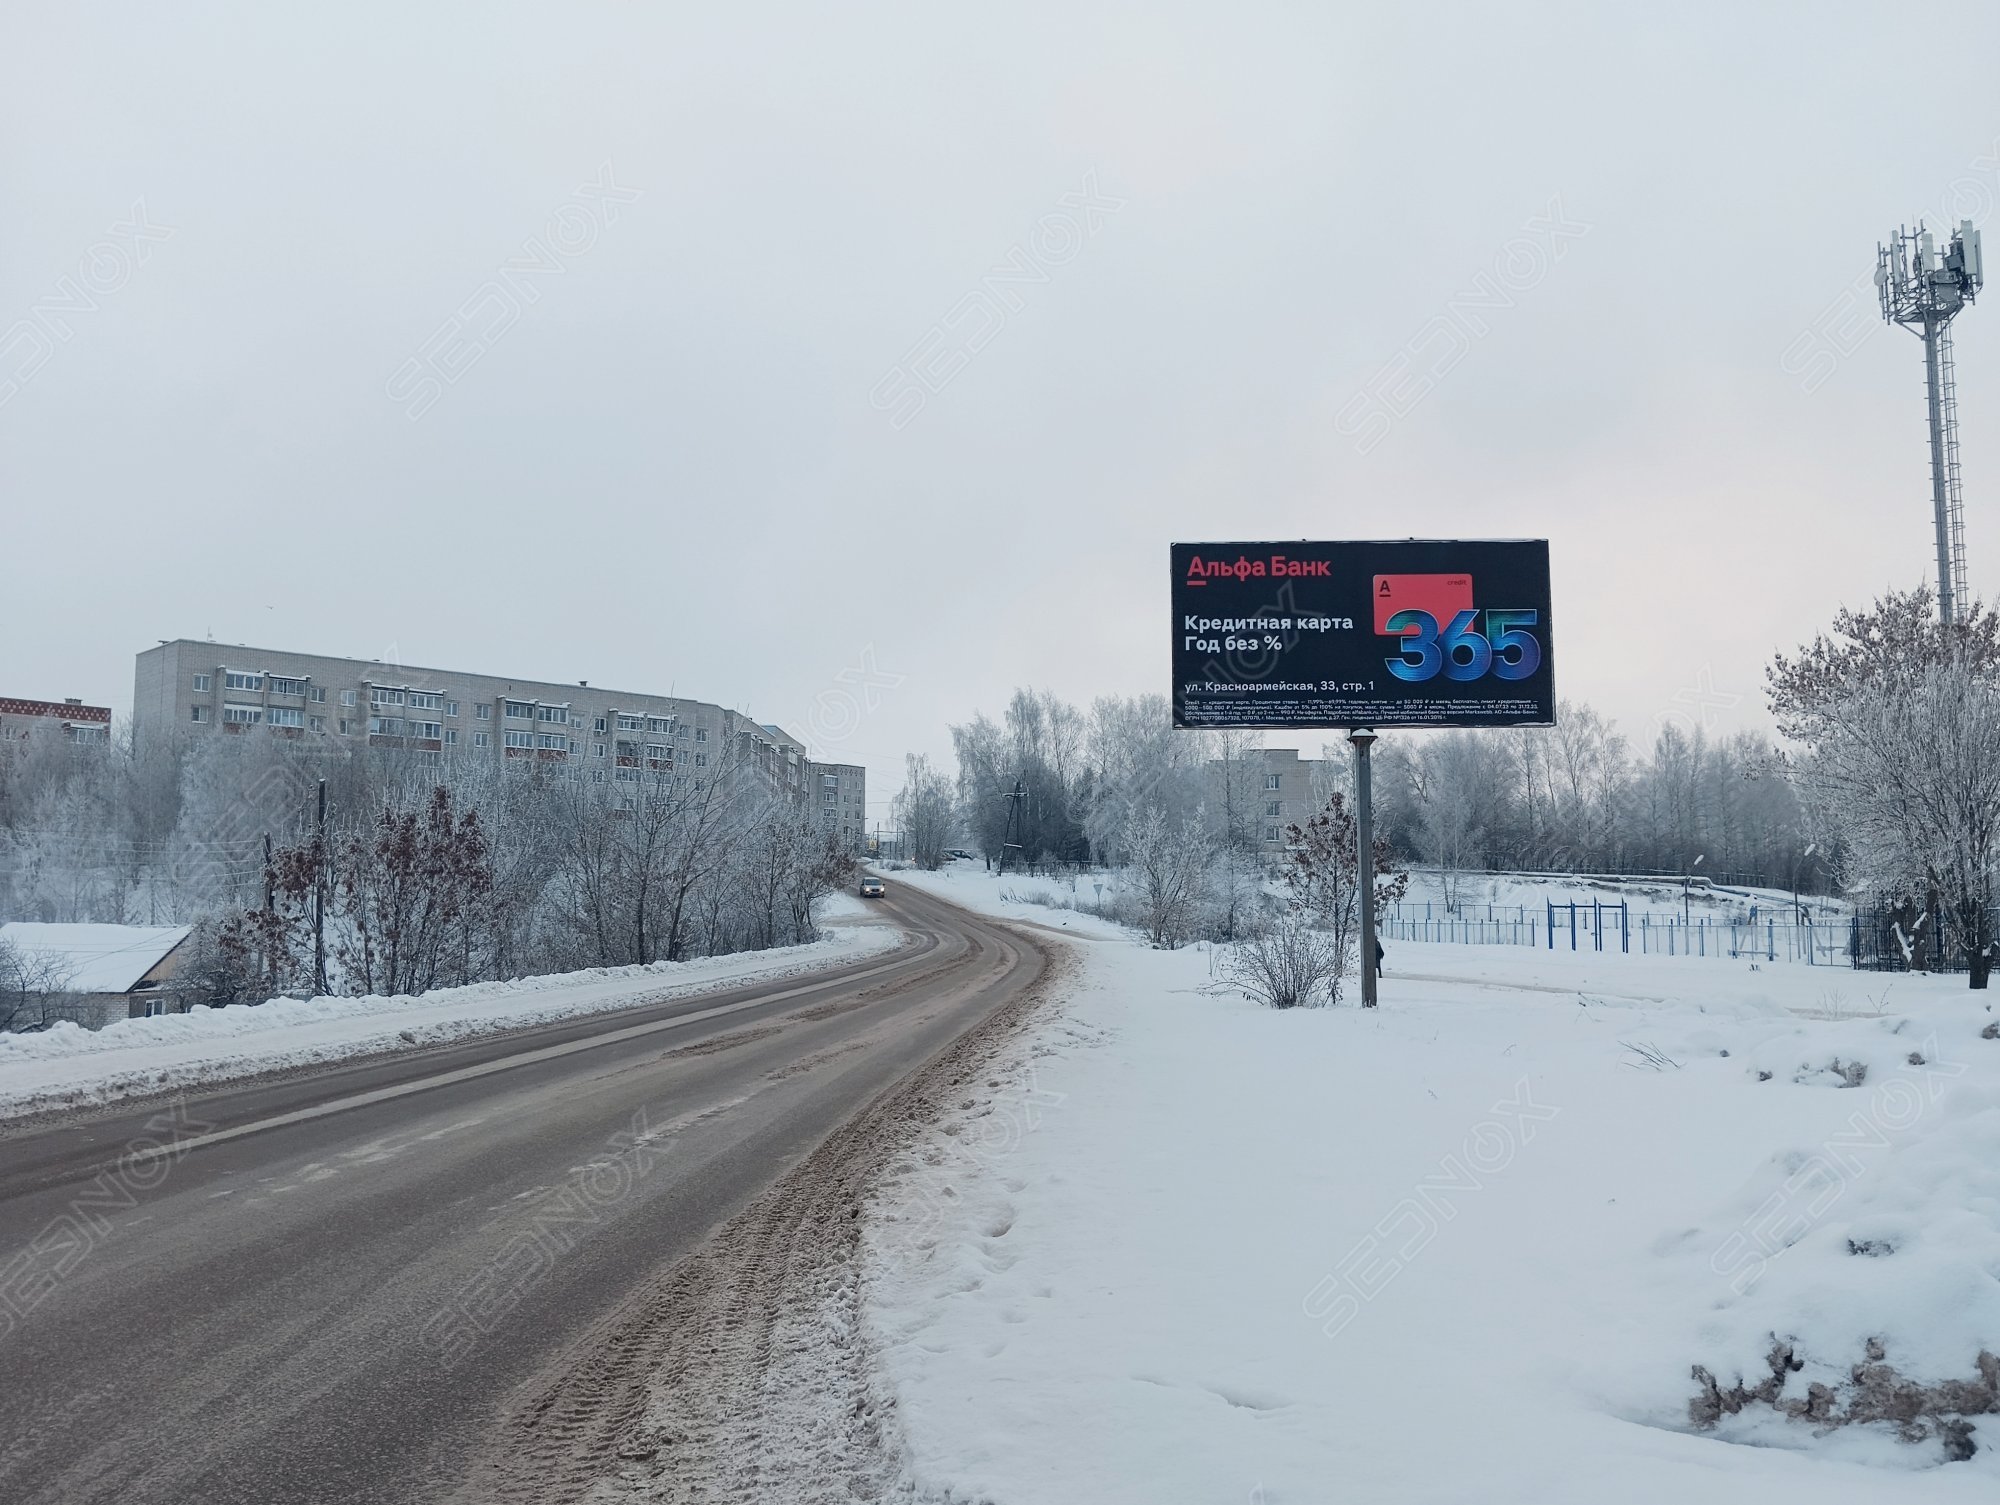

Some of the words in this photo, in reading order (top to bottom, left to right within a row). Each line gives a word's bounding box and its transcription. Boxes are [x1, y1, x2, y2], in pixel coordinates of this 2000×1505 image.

[1187, 556, 1266, 582] Альфа
[1271, 556, 1331, 577] Банк
[1185, 615, 1291, 633] Кредитная
[1297, 617, 1353, 633] карта
[1185, 636, 1221, 653] Год
[1225, 635, 1259, 652] без
[1264, 636, 1282, 651] %
[1384, 608, 1541, 682] 365
[1185, 683, 1202, 694] ул.
[1205, 681, 1317, 693] Красноармейская,
[1320, 681, 1340, 693] 33,
[1342, 683, 1366, 693] стр.
[1369, 680, 1374, 691] 1
